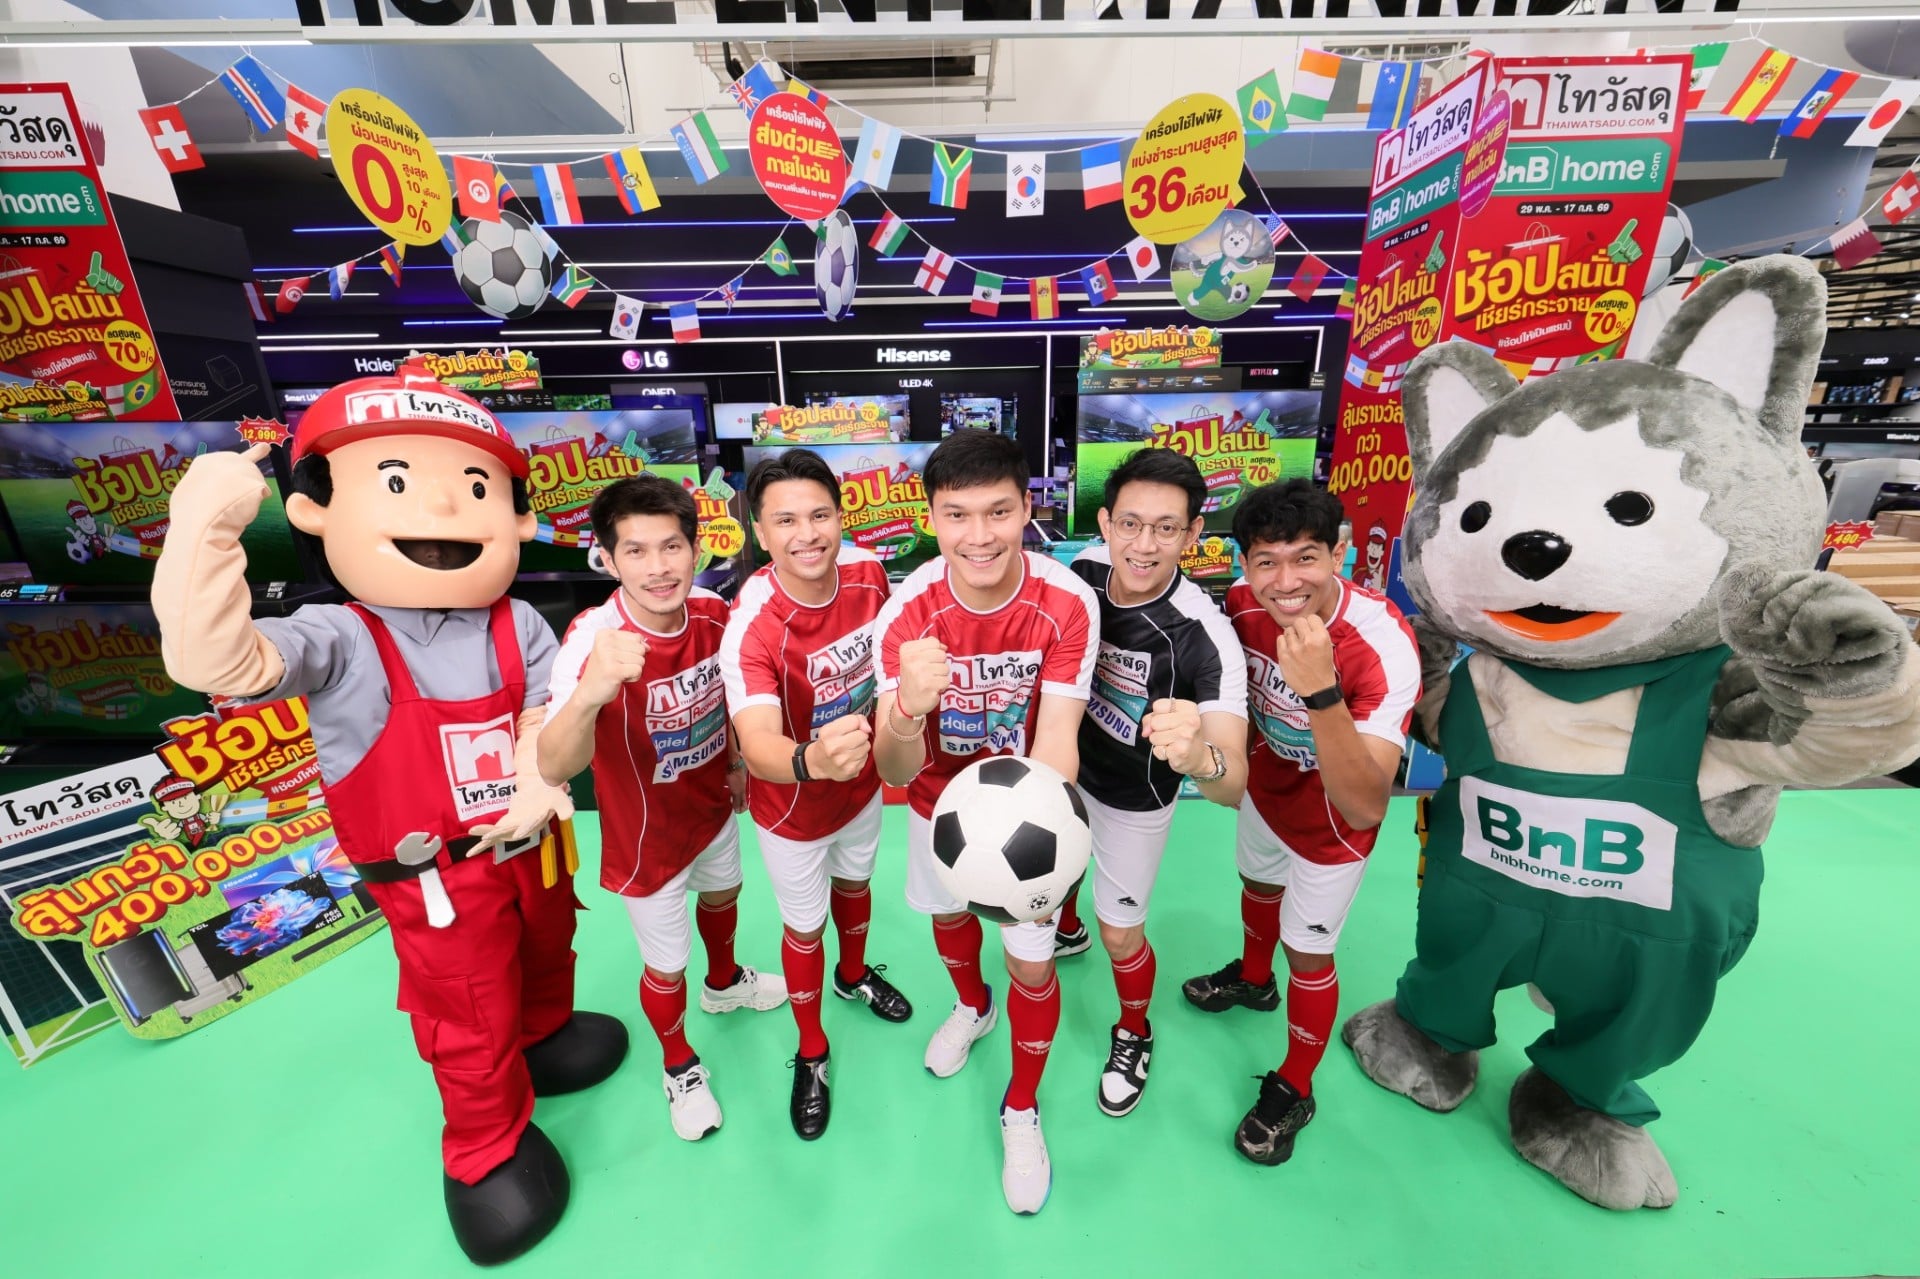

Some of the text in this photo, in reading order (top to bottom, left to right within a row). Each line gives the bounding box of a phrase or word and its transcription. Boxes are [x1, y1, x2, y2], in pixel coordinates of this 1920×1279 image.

[1555, 73, 1671, 124] ไทวัสดุ
[1408, 97, 1472, 157] ไทวัสดุ
[1545, 117, 1657, 130] THAIWATSADU.COM
[351, 121, 422, 162] ผ่อนสบายๆ
[756, 122, 834, 159] ส่งด่วน
[1131, 130, 1238, 168] แบ่งชำระนานสูงสุด
[402, 163, 428, 181] สูงสุด
[766, 155, 831, 185] ภายในวัน
[1562, 155, 1646, 183] home
[1651, 151, 1663, 183] .com
[1, 185, 96, 216] home .com
[406, 180, 420, 194] 10
[1129, 166, 1229, 219] 36 เดือน
[1371, 197, 1401, 232] BnB
[1404, 175, 1451, 215] home
[1452, 163, 1462, 193] .com
[1520, 204, 1533, 214] 29
[1535, 204, 1552, 213] พ.ค.
[1563, 203, 1576, 213] 17
[1578, 203, 1595, 213] ก.ค.
[1597, 203, 1610, 212] 69
[21, 235, 32, 246] 17
[54, 235, 66, 246] 69
[1455, 243, 1629, 318] ช้อปสนั่น
[1352, 262, 1437, 339] ช้อปสนั่น
[1475, 296, 1592, 332] เชียร์กระจาย
[1594, 300, 1629, 312] ลดสูงสุด
[1109, 326, 1188, 357] ช้อปสนั่น
[1360, 308, 1416, 349] เชียร์กระจาย
[643, 351, 669, 368] LG
[876, 348, 951, 363] Hisense
[284, 393, 302, 402] Smart
[921, 379, 934, 388] 4K
[779, 402, 856, 432] ช้อปสนั่น
[1356, 428, 1382, 454] กว่า
[526, 442, 645, 492] อปสนั่น
[1327, 454, 1413, 496] 400,000
[818, 682, 843, 702] TCL
[944, 695, 980, 710] TCL
[648, 717, 688, 730] TCL
[812, 702, 850, 723] Haier
[940, 716, 984, 733] Haier
[662, 733, 725, 779] SAMSUNG
[0, 776, 145, 827] ไทวัสดุ
[6, 797, 133, 841] THAIWATSADU.COM
[1477, 795, 1645, 875] BnB
[91, 811, 333, 947] 400,000 บาท
[223, 871, 259, 889] Hisense
[1490, 848, 1624, 890] bnbhome.com
[19, 843, 188, 936] ลุ้นกว่า
[190, 922, 209, 934] TCL
[314, 921, 326, 929] 4K
